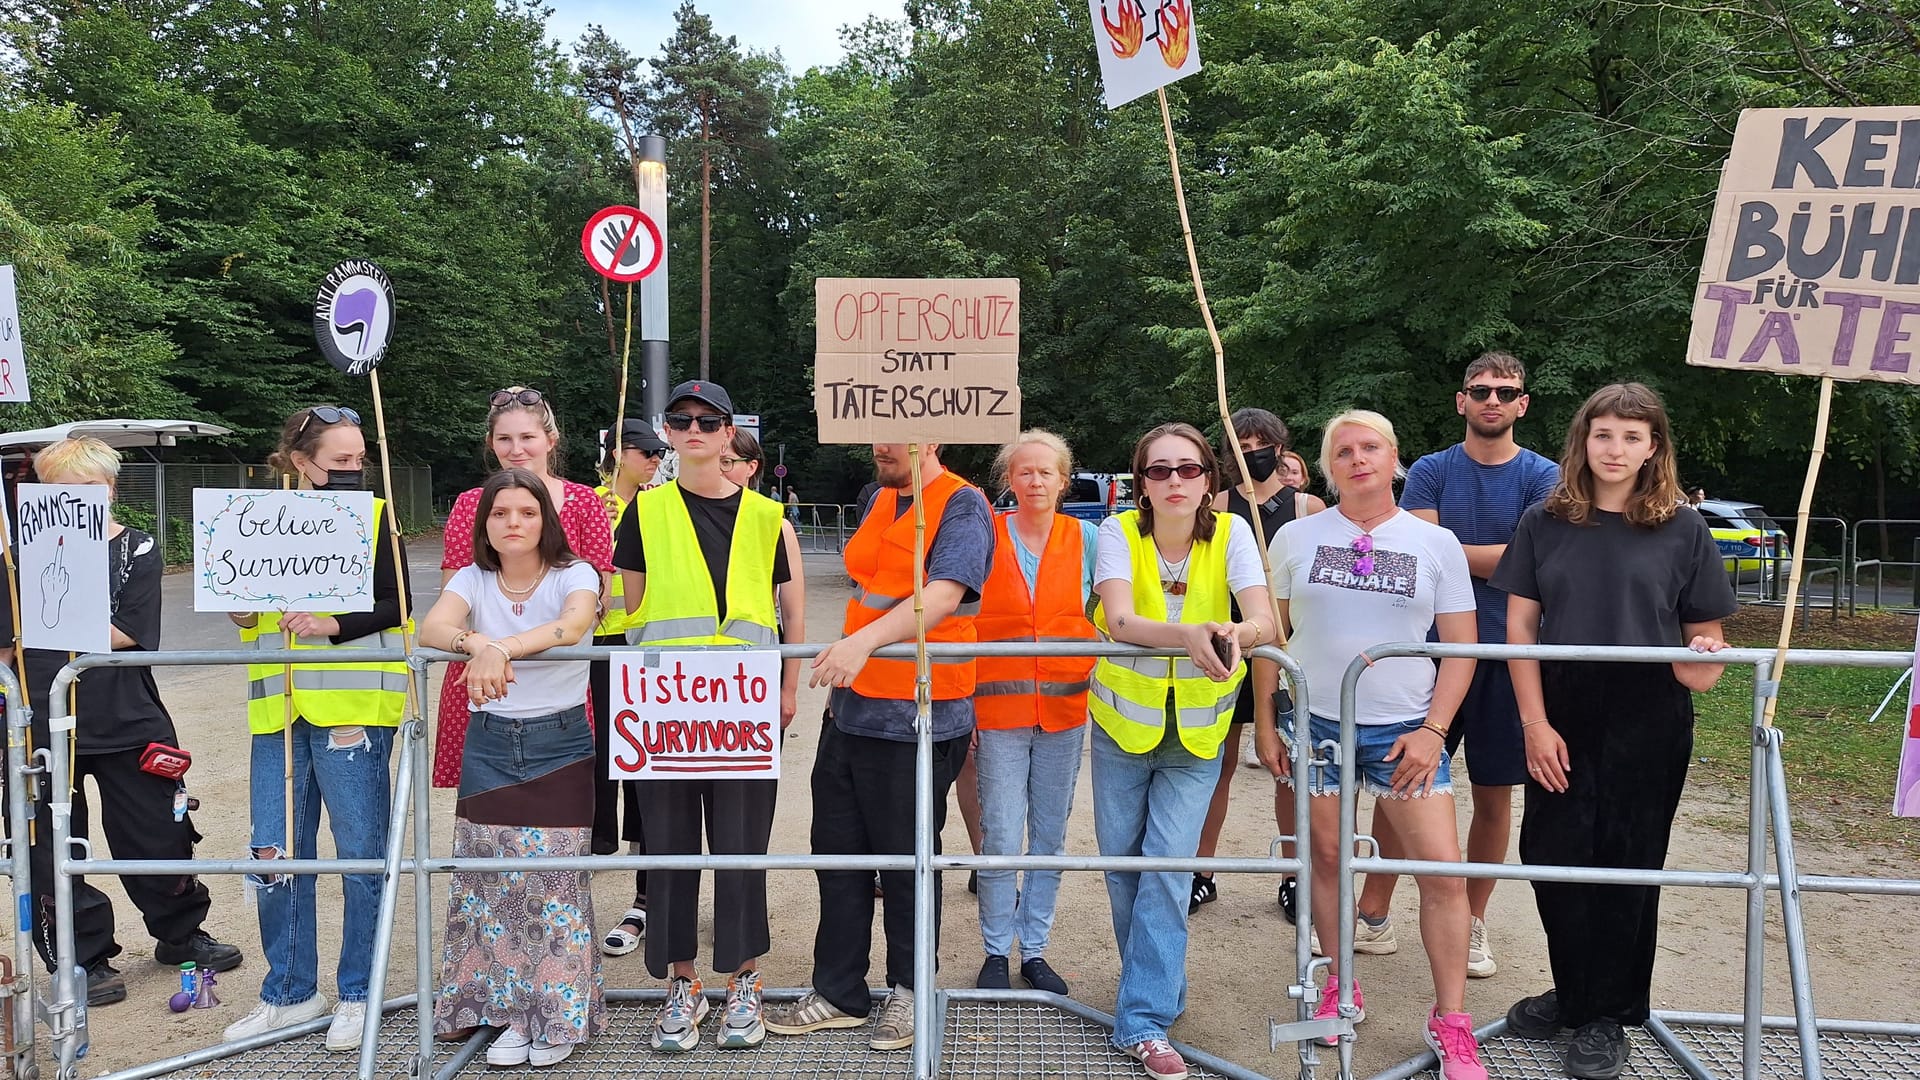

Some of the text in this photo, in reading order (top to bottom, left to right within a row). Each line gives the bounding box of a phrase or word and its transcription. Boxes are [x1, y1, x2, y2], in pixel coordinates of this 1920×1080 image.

[1770, 117, 1920, 190] KEI
[315, 260, 390, 321] ANTI RAMMSTEIN
[1751, 274, 1820, 309] FÜR
[834, 291, 1015, 342] OPFERSCHUTZ
[1703, 284, 1920, 374] TÄTE
[881, 349, 956, 374] STATT
[823, 377, 1015, 420] TÄTERSCHUTZ
[20, 491, 104, 546] RAMMSTEIN
[236, 500, 337, 537] believe
[217, 549, 363, 586] Survivors
[1318, 567, 1409, 592] FEMALE
[622, 661, 768, 705] listen to
